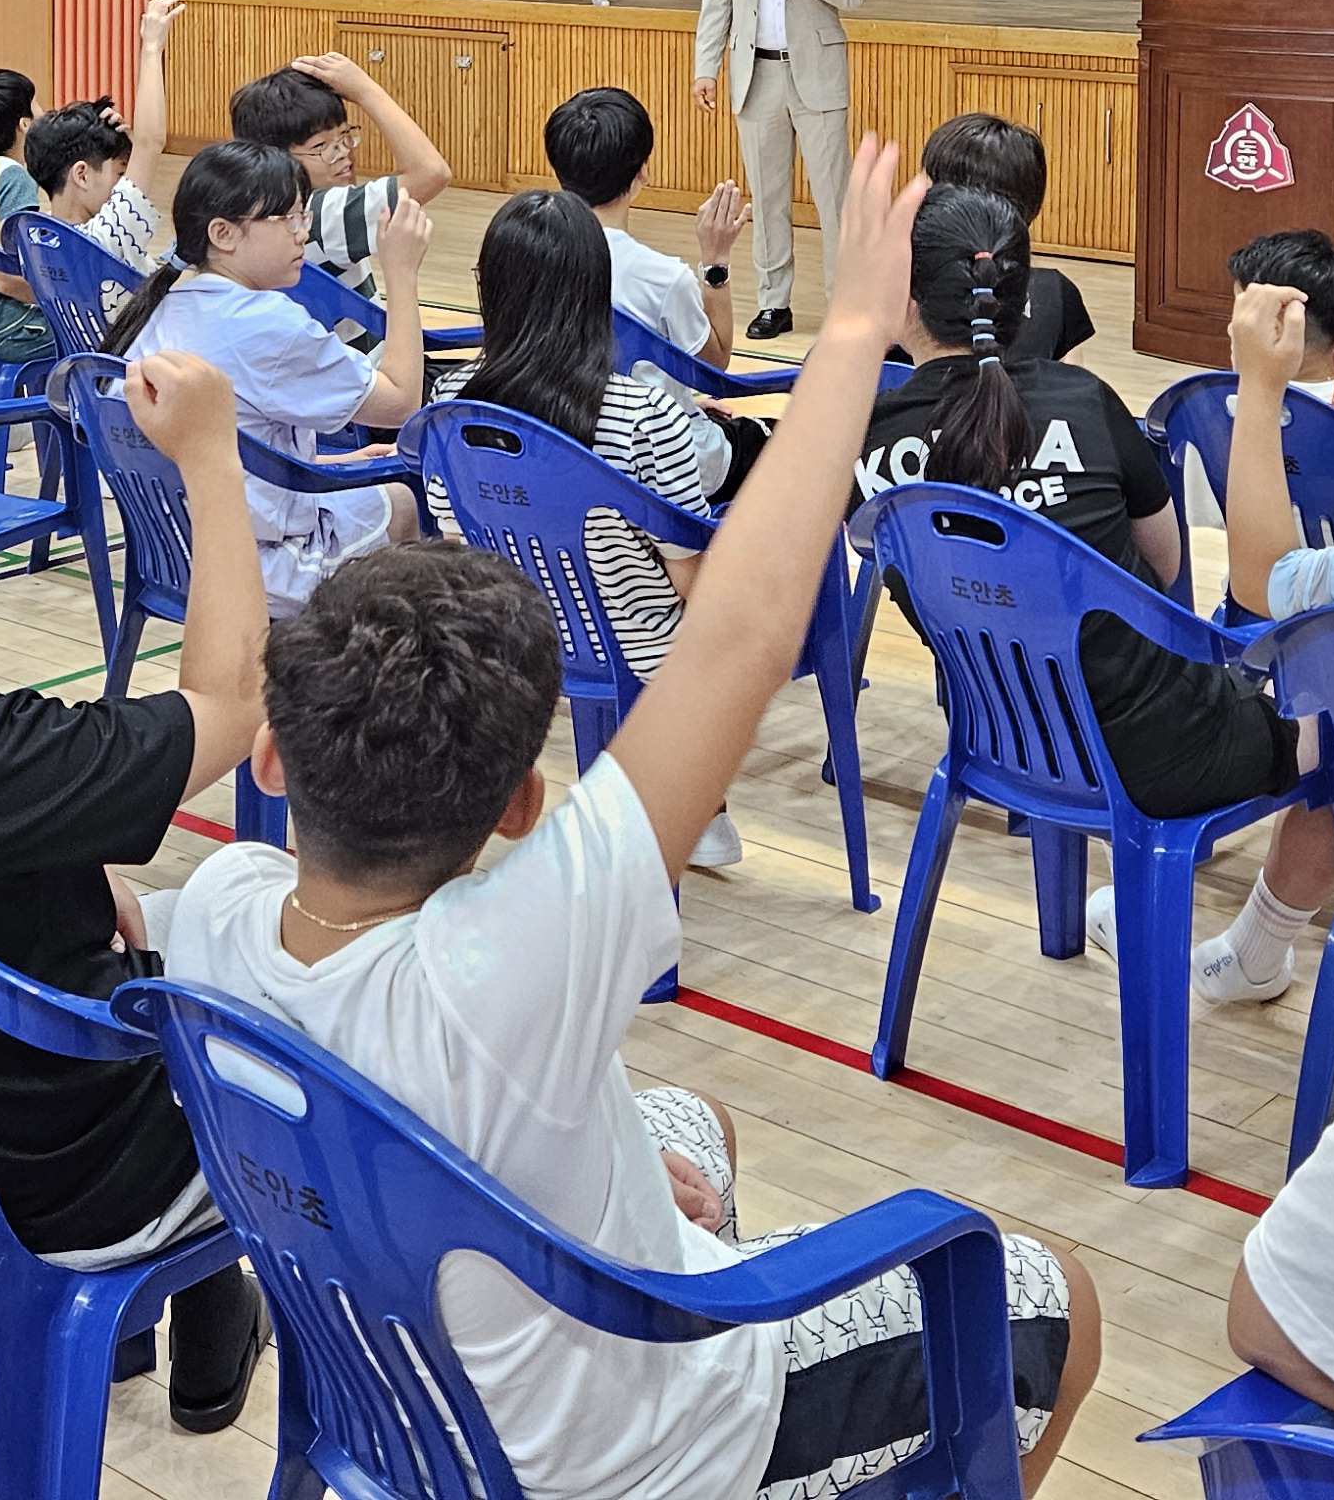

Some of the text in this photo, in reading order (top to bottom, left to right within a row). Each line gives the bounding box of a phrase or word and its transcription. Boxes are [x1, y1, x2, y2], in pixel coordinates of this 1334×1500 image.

[1236, 139, 1259, 171] 도안
[478, 480, 531, 507] 도안초
[951, 575, 1017, 609] 도안초
[237, 1149, 334, 1232] 도안초
